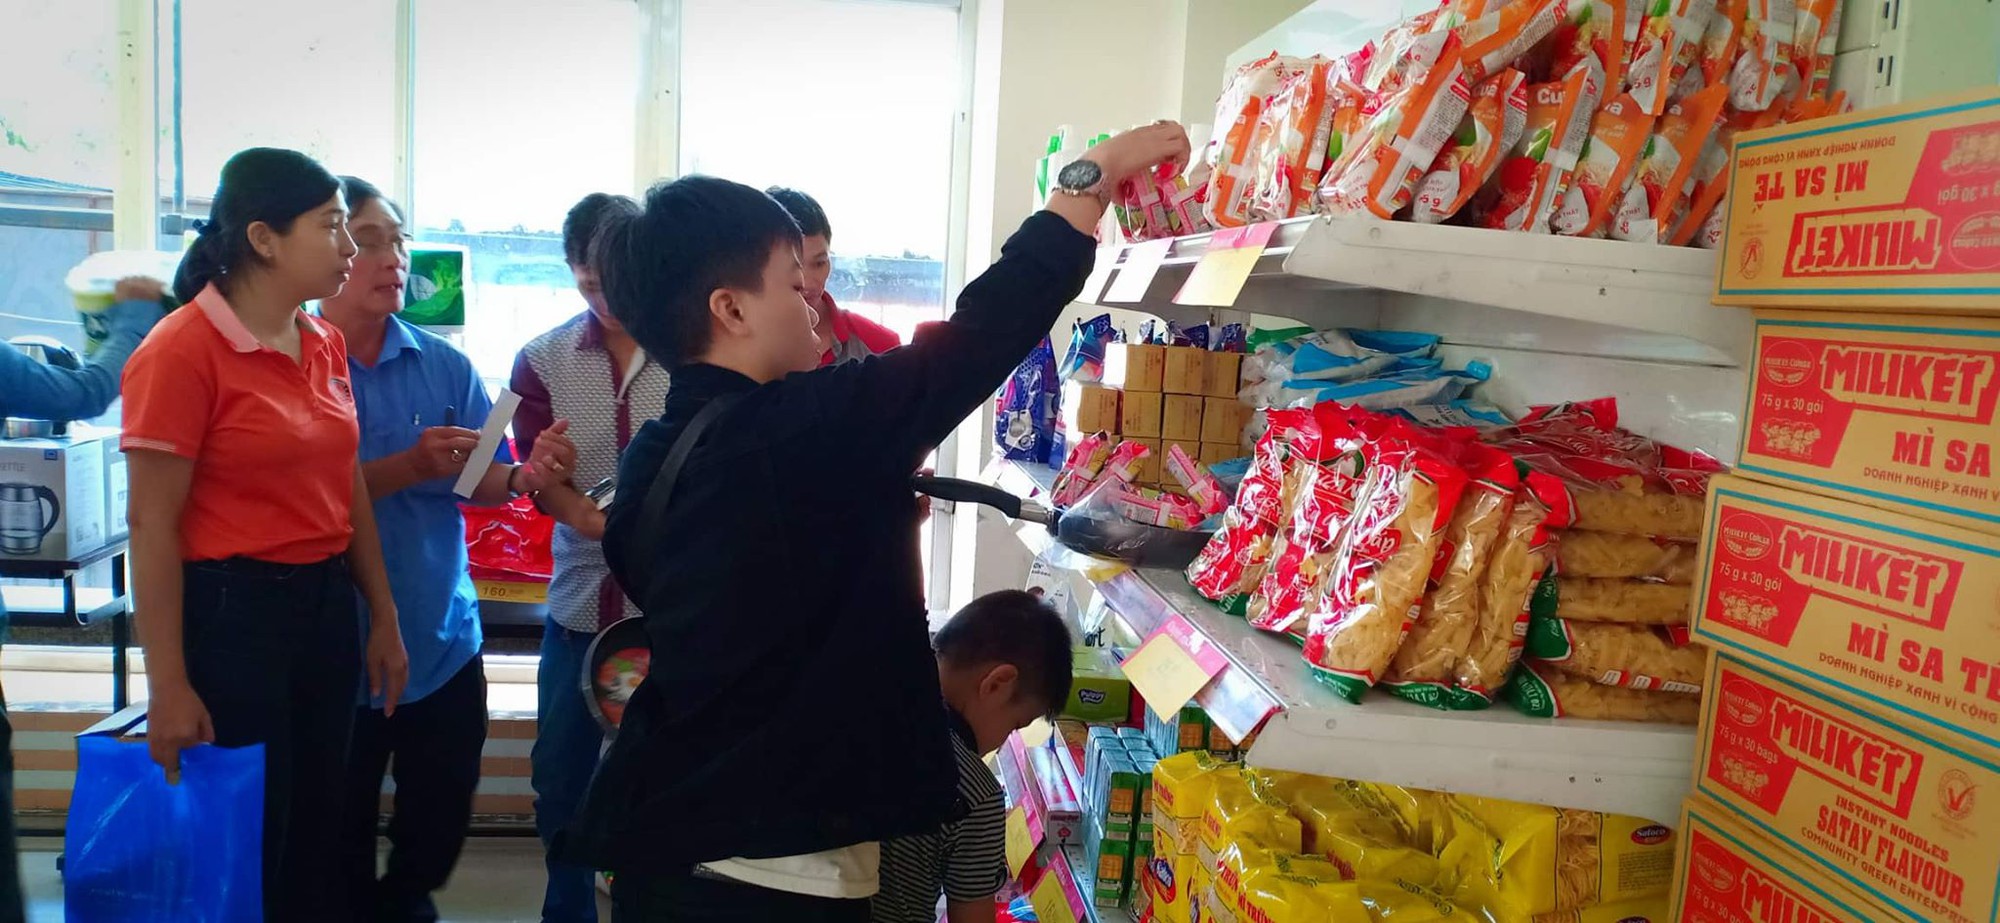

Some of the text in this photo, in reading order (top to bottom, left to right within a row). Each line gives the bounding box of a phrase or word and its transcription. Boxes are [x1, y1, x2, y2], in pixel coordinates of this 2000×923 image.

[1537, 87, 1564, 104] Cu
[1796, 148, 1822, 160] XANH
[1860, 136, 1896, 150] DOANH
[1752, 160, 1869, 214] MÌ SA TẾ
[1799, 219, 1938, 269] MILIKET
[1823, 348, 1986, 406] MILIKET
[1762, 393, 1773, 407] 75
[1774, 397, 1782, 411] g
[1792, 397, 1805, 411] 30
[1806, 399, 1824, 415] gói
[1892, 426, 1991, 478] MÌ SA
[1864, 467, 1902, 483] DOANH
[1906, 474, 1949, 493] NGHIỆP
[1952, 483, 1988, 500] XANH
[482, 586, 506, 597] 160
[1720, 561, 1782, 592] 75 g x 30 gói
[1783, 530, 1941, 608] MILIKET
[1847, 622, 1889, 663] MÌ
[1898, 639, 1944, 683] SA
[1819, 652, 1857, 675] DOANH
[1859, 666, 1903, 690] NGHIỆP
[1906, 683, 1941, 704] XANH
[1944, 694, 1957, 711] VÌ
[1720, 724, 1730, 739] 75
[1744, 737, 1756, 752] 30
[1757, 743, 1779, 764] bags
[1774, 701, 1904, 803] MILIKET
[1835, 795, 1888, 829] INSTANT
[1890, 823, 1950, 863] NOODLES
[1801, 827, 1860, 867] COMMUNITY
[1861, 860, 1898, 890] GREEN
[1817, 804, 1873, 855] SATAY
[1875, 835, 1965, 907] FLAVOUR
